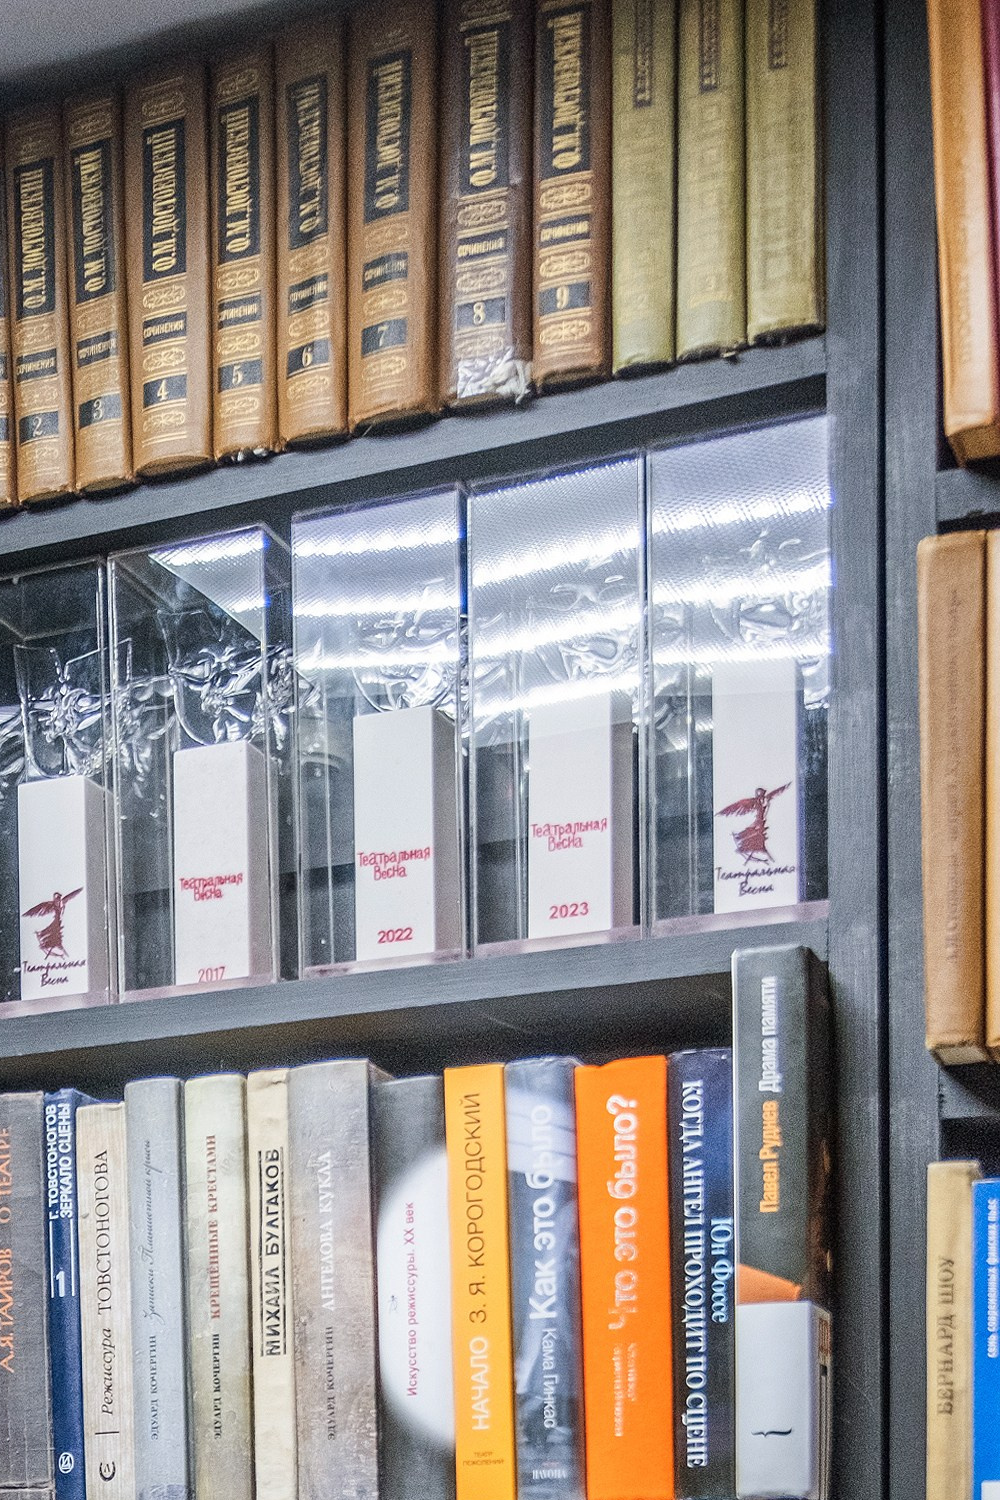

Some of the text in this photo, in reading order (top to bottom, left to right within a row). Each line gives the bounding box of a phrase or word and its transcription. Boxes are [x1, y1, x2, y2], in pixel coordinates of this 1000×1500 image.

[556, 285, 569, 309] 9
[472, 301, 486, 325] 8
[378, 325, 389, 347] 7
[301, 347, 313, 367] 6
[231, 364, 243, 384] 5
[157, 378, 168, 400] 4
[92, 398, 102, 420] 3
[32, 416, 43, 437] 2
[530, 817, 608, 839] Театральная
[547, 836, 584, 852] Весна
[357, 844, 431, 868] Театральная
[179, 872, 244, 892] Театральная
[373, 864, 408, 882] Весна
[193, 886, 224, 901] Весна
[738, 881, 775, 898] Весна
[548, 901, 589, 920] 2023
[377, 926, 414, 945] 2022
[40, 973, 69, 988] Весна
[197, 965, 226, 984] 2017
[758, 977, 781, 1213] Павел Руднев Драма памяти
[59, 1103, 73, 1218] ЗЕРКАЛО СЦЕНЫ
[524, 1103, 563, 1320] Как это было
[264, 1149, 282, 1356] МИХАИЛ БУЛГАКОВ
[460, 1093, 492, 1431] НАЧАЛО З. Я. КОРОГОДСКИЙ
[679, 1079, 707, 1468] КОГДА АНГЕЛ ПРОХОДИТ ПО СЦЕНЕ
[708, 1217, 733, 1324] Юн Фоссе
[55, 1270, 66, 1298] 1
[94, 1150, 116, 1416] Режиссура ТОВСТОНОГОВА
[206, 1134, 222, 1440] ЭДУАРД КОЧЕРГИН КРЕЩЁННЫЕ КРЕСТАМИ
[937, 1256, 957, 1416] БЕРНАРД ШОУ
